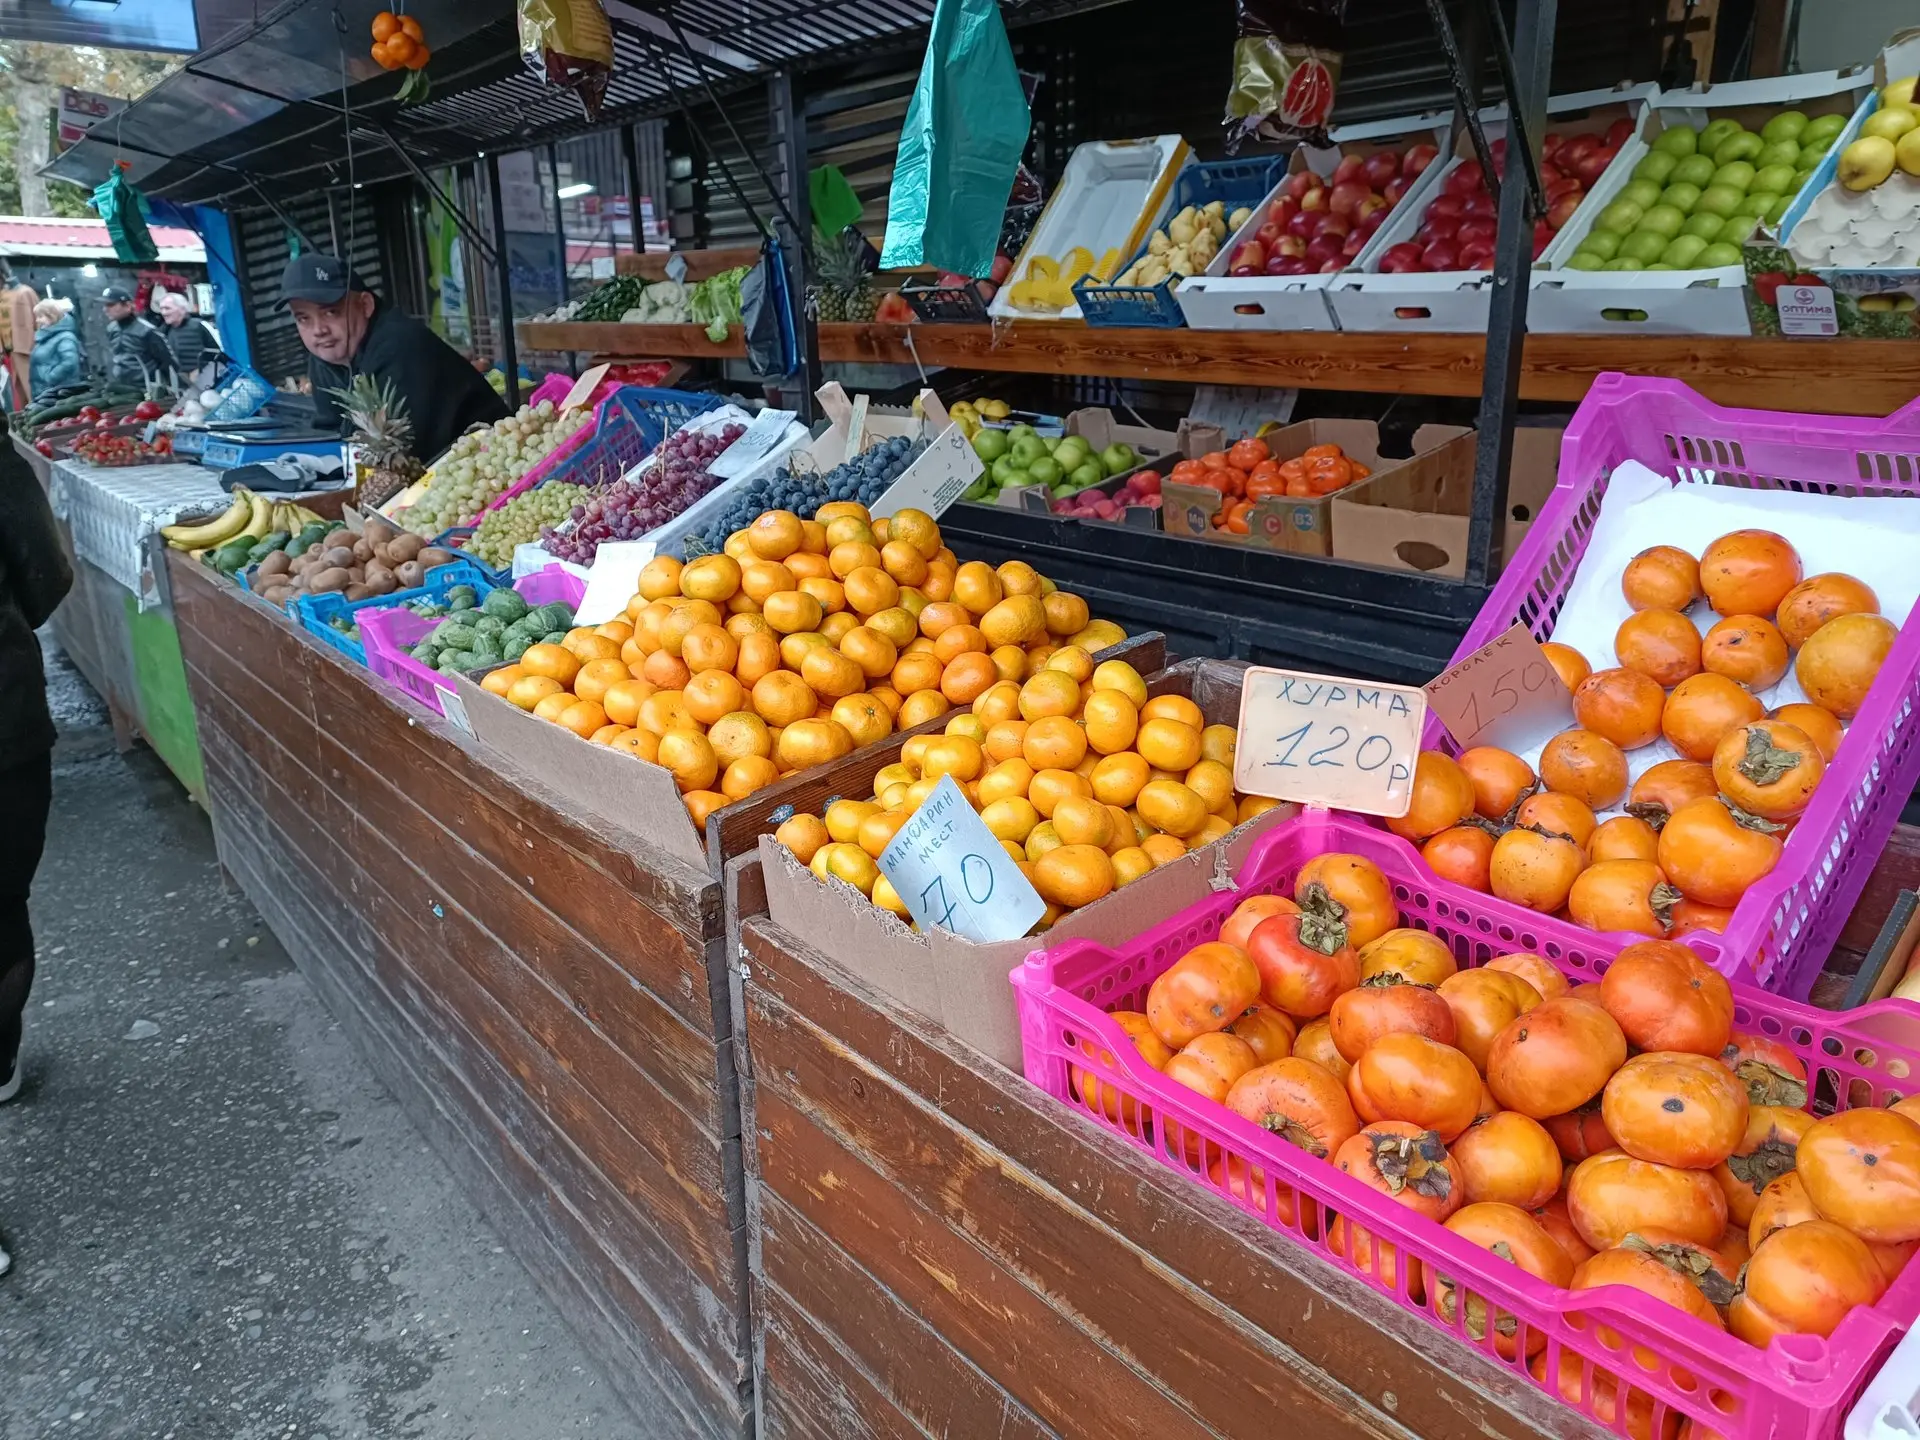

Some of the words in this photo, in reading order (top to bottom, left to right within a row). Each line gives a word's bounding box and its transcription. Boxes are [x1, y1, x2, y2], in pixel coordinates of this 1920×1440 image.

[64, 93, 109, 116] Dole
[1188, 511, 1204, 529] Mg
[1265, 518, 1278, 532] C
[1294, 512, 1314, 526] B3
[1275, 678, 1412, 718] ХУРМА
[885, 790, 955, 873] МАНДАРИН
[918, 819, 954, 865] МЕСТ
[920, 853, 994, 934] 70
